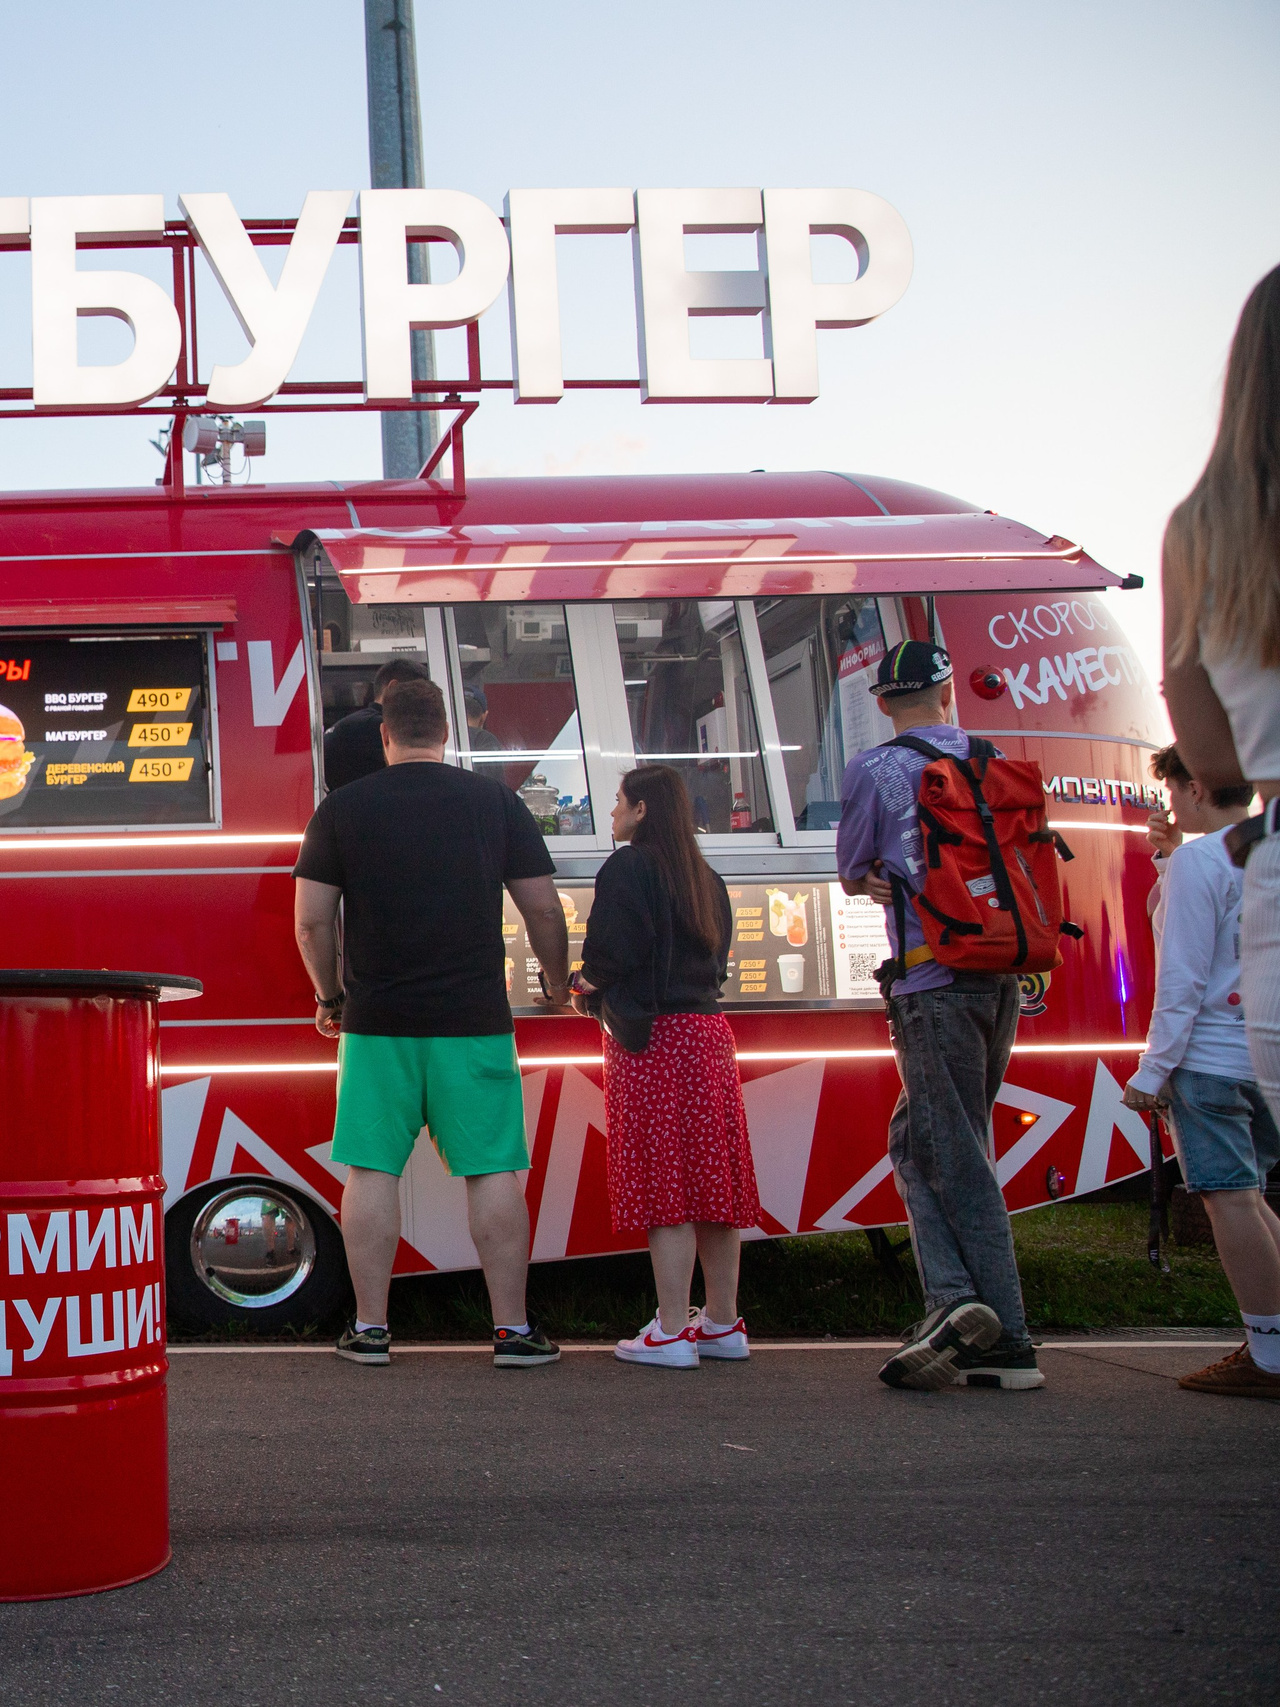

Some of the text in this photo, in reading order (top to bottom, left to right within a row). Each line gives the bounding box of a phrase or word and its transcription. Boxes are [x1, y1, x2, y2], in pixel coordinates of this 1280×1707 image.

[988, 600, 1114, 649] СКОРОС
[1003, 646, 1142, 709] КАЧЕСТ
[45, 692, 108, 704] BBQ БУРГЕР
[137, 693, 169, 707] 490
[46, 730, 108, 741] МАГБУРГЕР
[138, 728, 171, 741] 450
[46, 761, 125, 775] ДЕРЕВЕНСКИЙ
[139, 763, 172, 777] 450
[46, 774, 88, 785] БУРГЕР
[573, 924, 586, 932] 450
